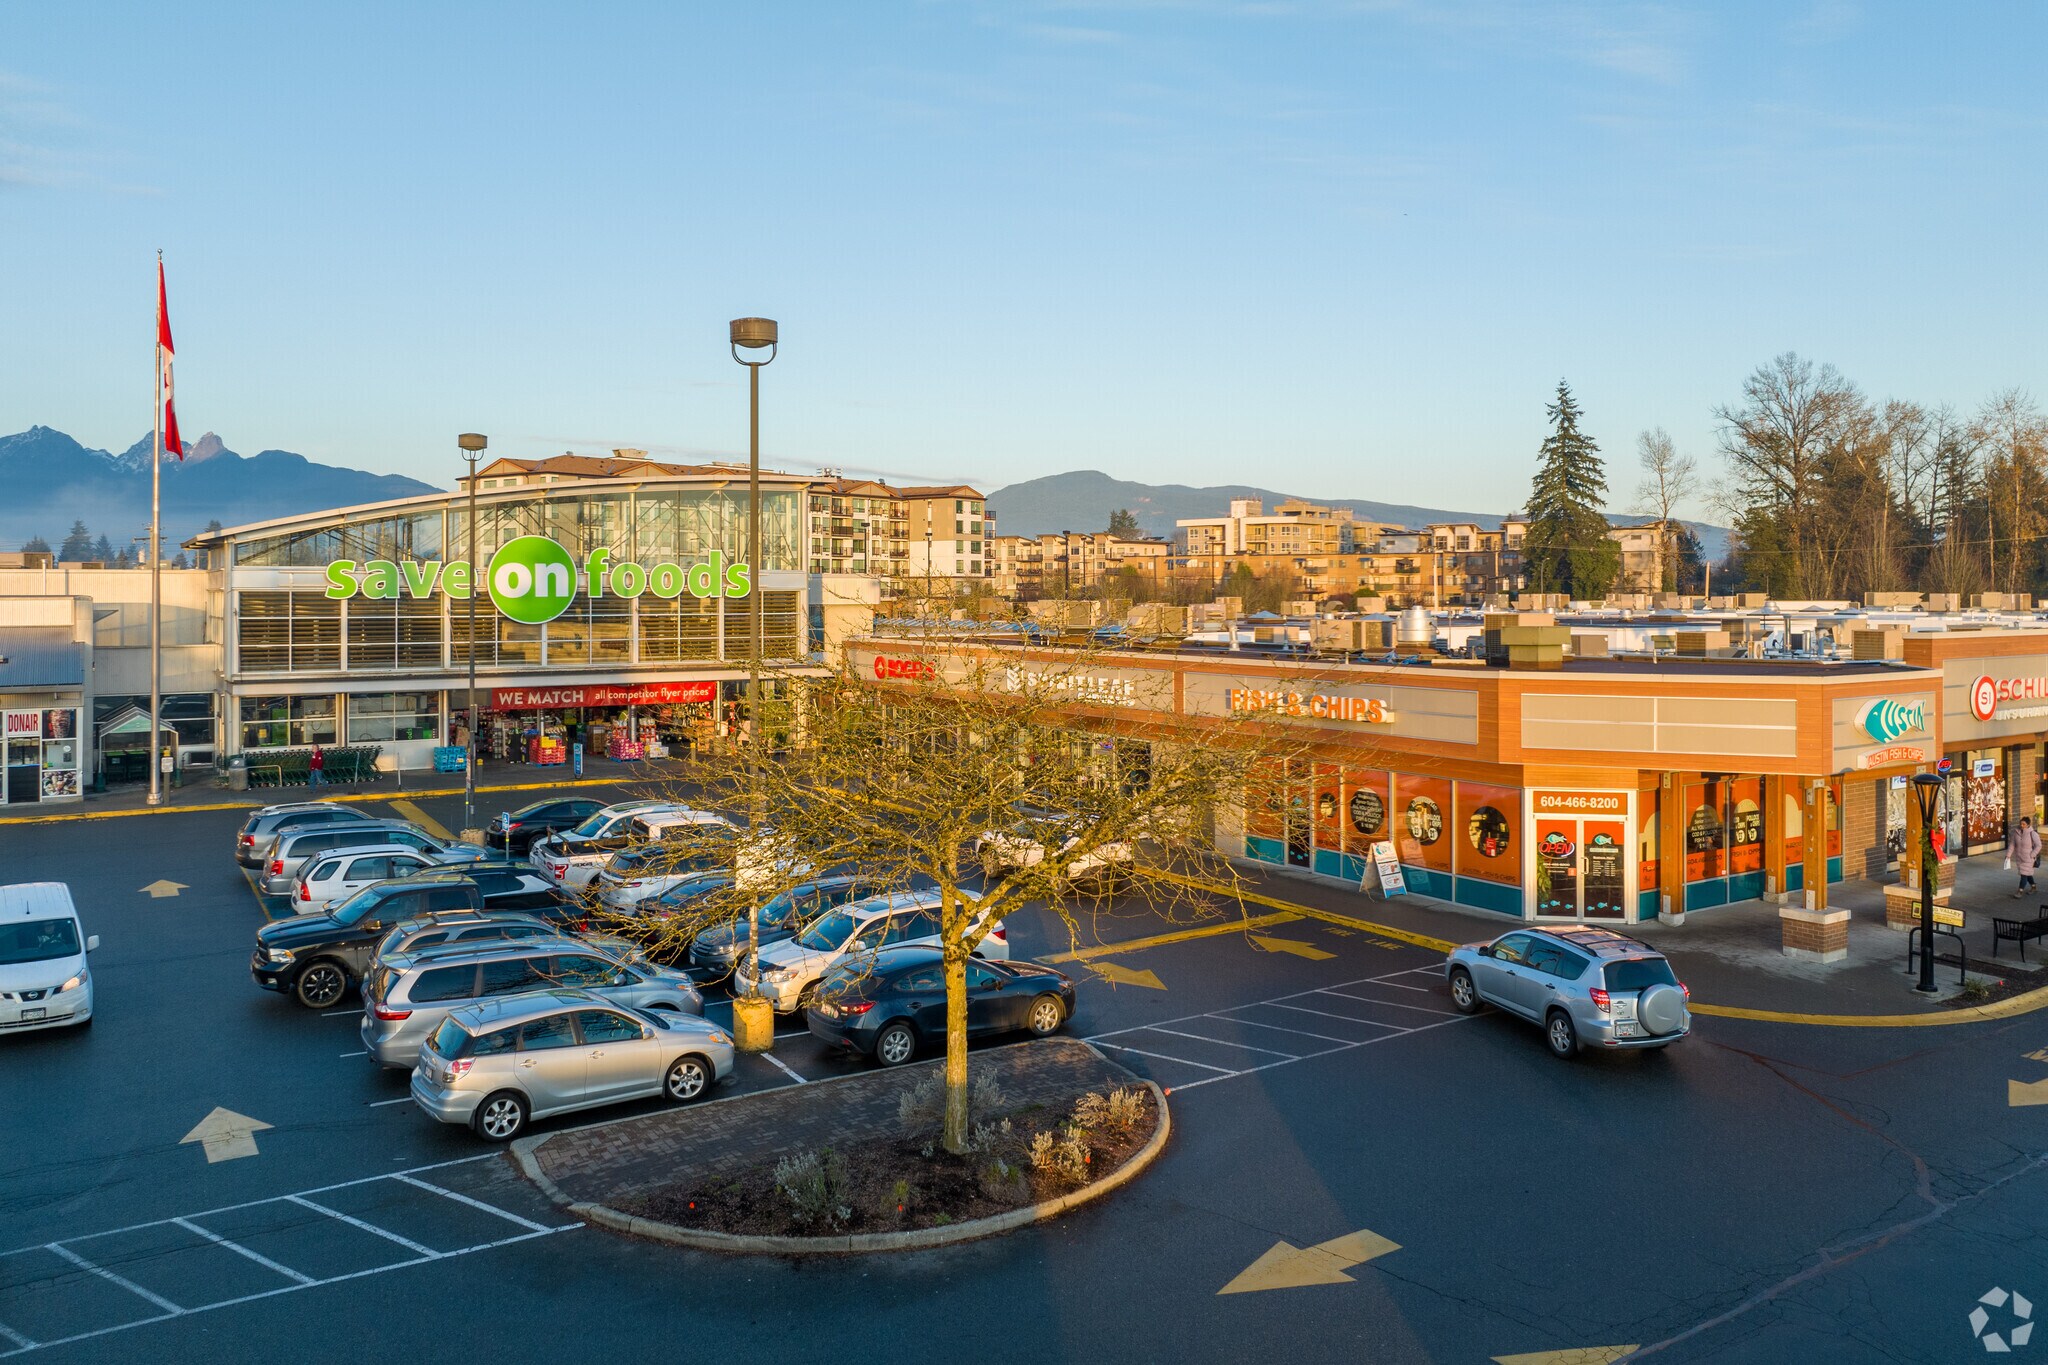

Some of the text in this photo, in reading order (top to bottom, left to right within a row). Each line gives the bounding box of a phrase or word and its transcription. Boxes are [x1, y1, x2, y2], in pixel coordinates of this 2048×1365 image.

[325, 548, 751, 599] save on foods
[498, 691, 524, 706] WE
[527, 689, 585, 706] MATCH
[594, 689, 606, 700] all
[607, 689, 659, 703] competitor
[660, 687, 681, 701] flyer
[1231, 688, 1388, 724] FISH & CHIPS
[7, 713, 39, 733] DONAIR
[1868, 750, 1889, 768] AUSTIN
[1890, 748, 1902, 760] FISH
[1907, 748, 1924, 762] CHIPS
[1540, 795, 1619, 809] 604-466-8200
[1540, 842, 1572, 855] OPEN
